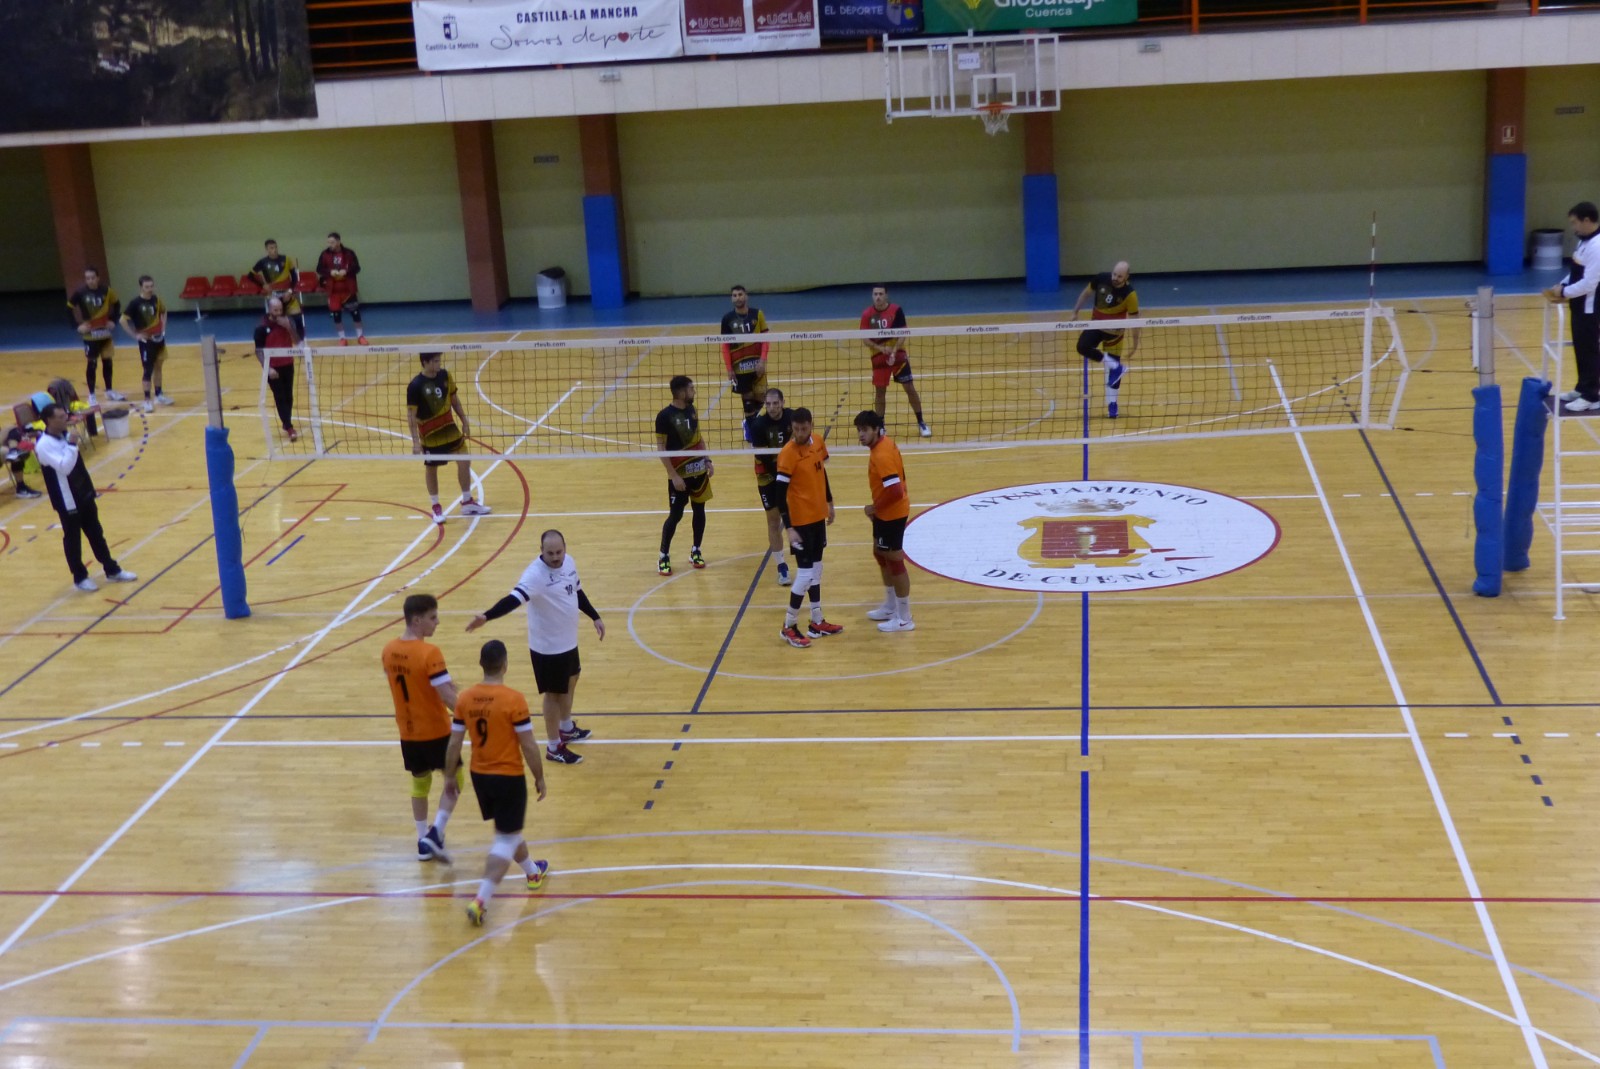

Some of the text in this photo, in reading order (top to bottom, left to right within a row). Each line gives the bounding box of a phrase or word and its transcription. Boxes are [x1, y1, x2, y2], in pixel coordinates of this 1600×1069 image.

[516, 6, 638, 23] CASTILLA-LA MANCHA
[824, 5, 884, 16] EL DEPORTE
[1025, 8, 1073, 18] Cuenca
[697, 16, 743, 29] UCLM
[766, 11, 812, 25] UCLM
[1105, 294, 1113, 303] 8
[876, 318, 888, 329] 10
[1146, 318, 1180, 326] rfevb.com
[1237, 314, 1272, 322] rfevb.com
[739, 322, 751, 333] 11
[878, 329, 911, 337] rfevb.com
[435, 387, 442, 398] 9
[777, 432, 784, 443] 5
[670, 496, 676, 504] 7
[969, 485, 1208, 511] AYUNTAMIENTO
[982, 565, 1199, 585] DE CUENCA
[395, 674, 410, 703] 1
[476, 718, 488, 748] 9
